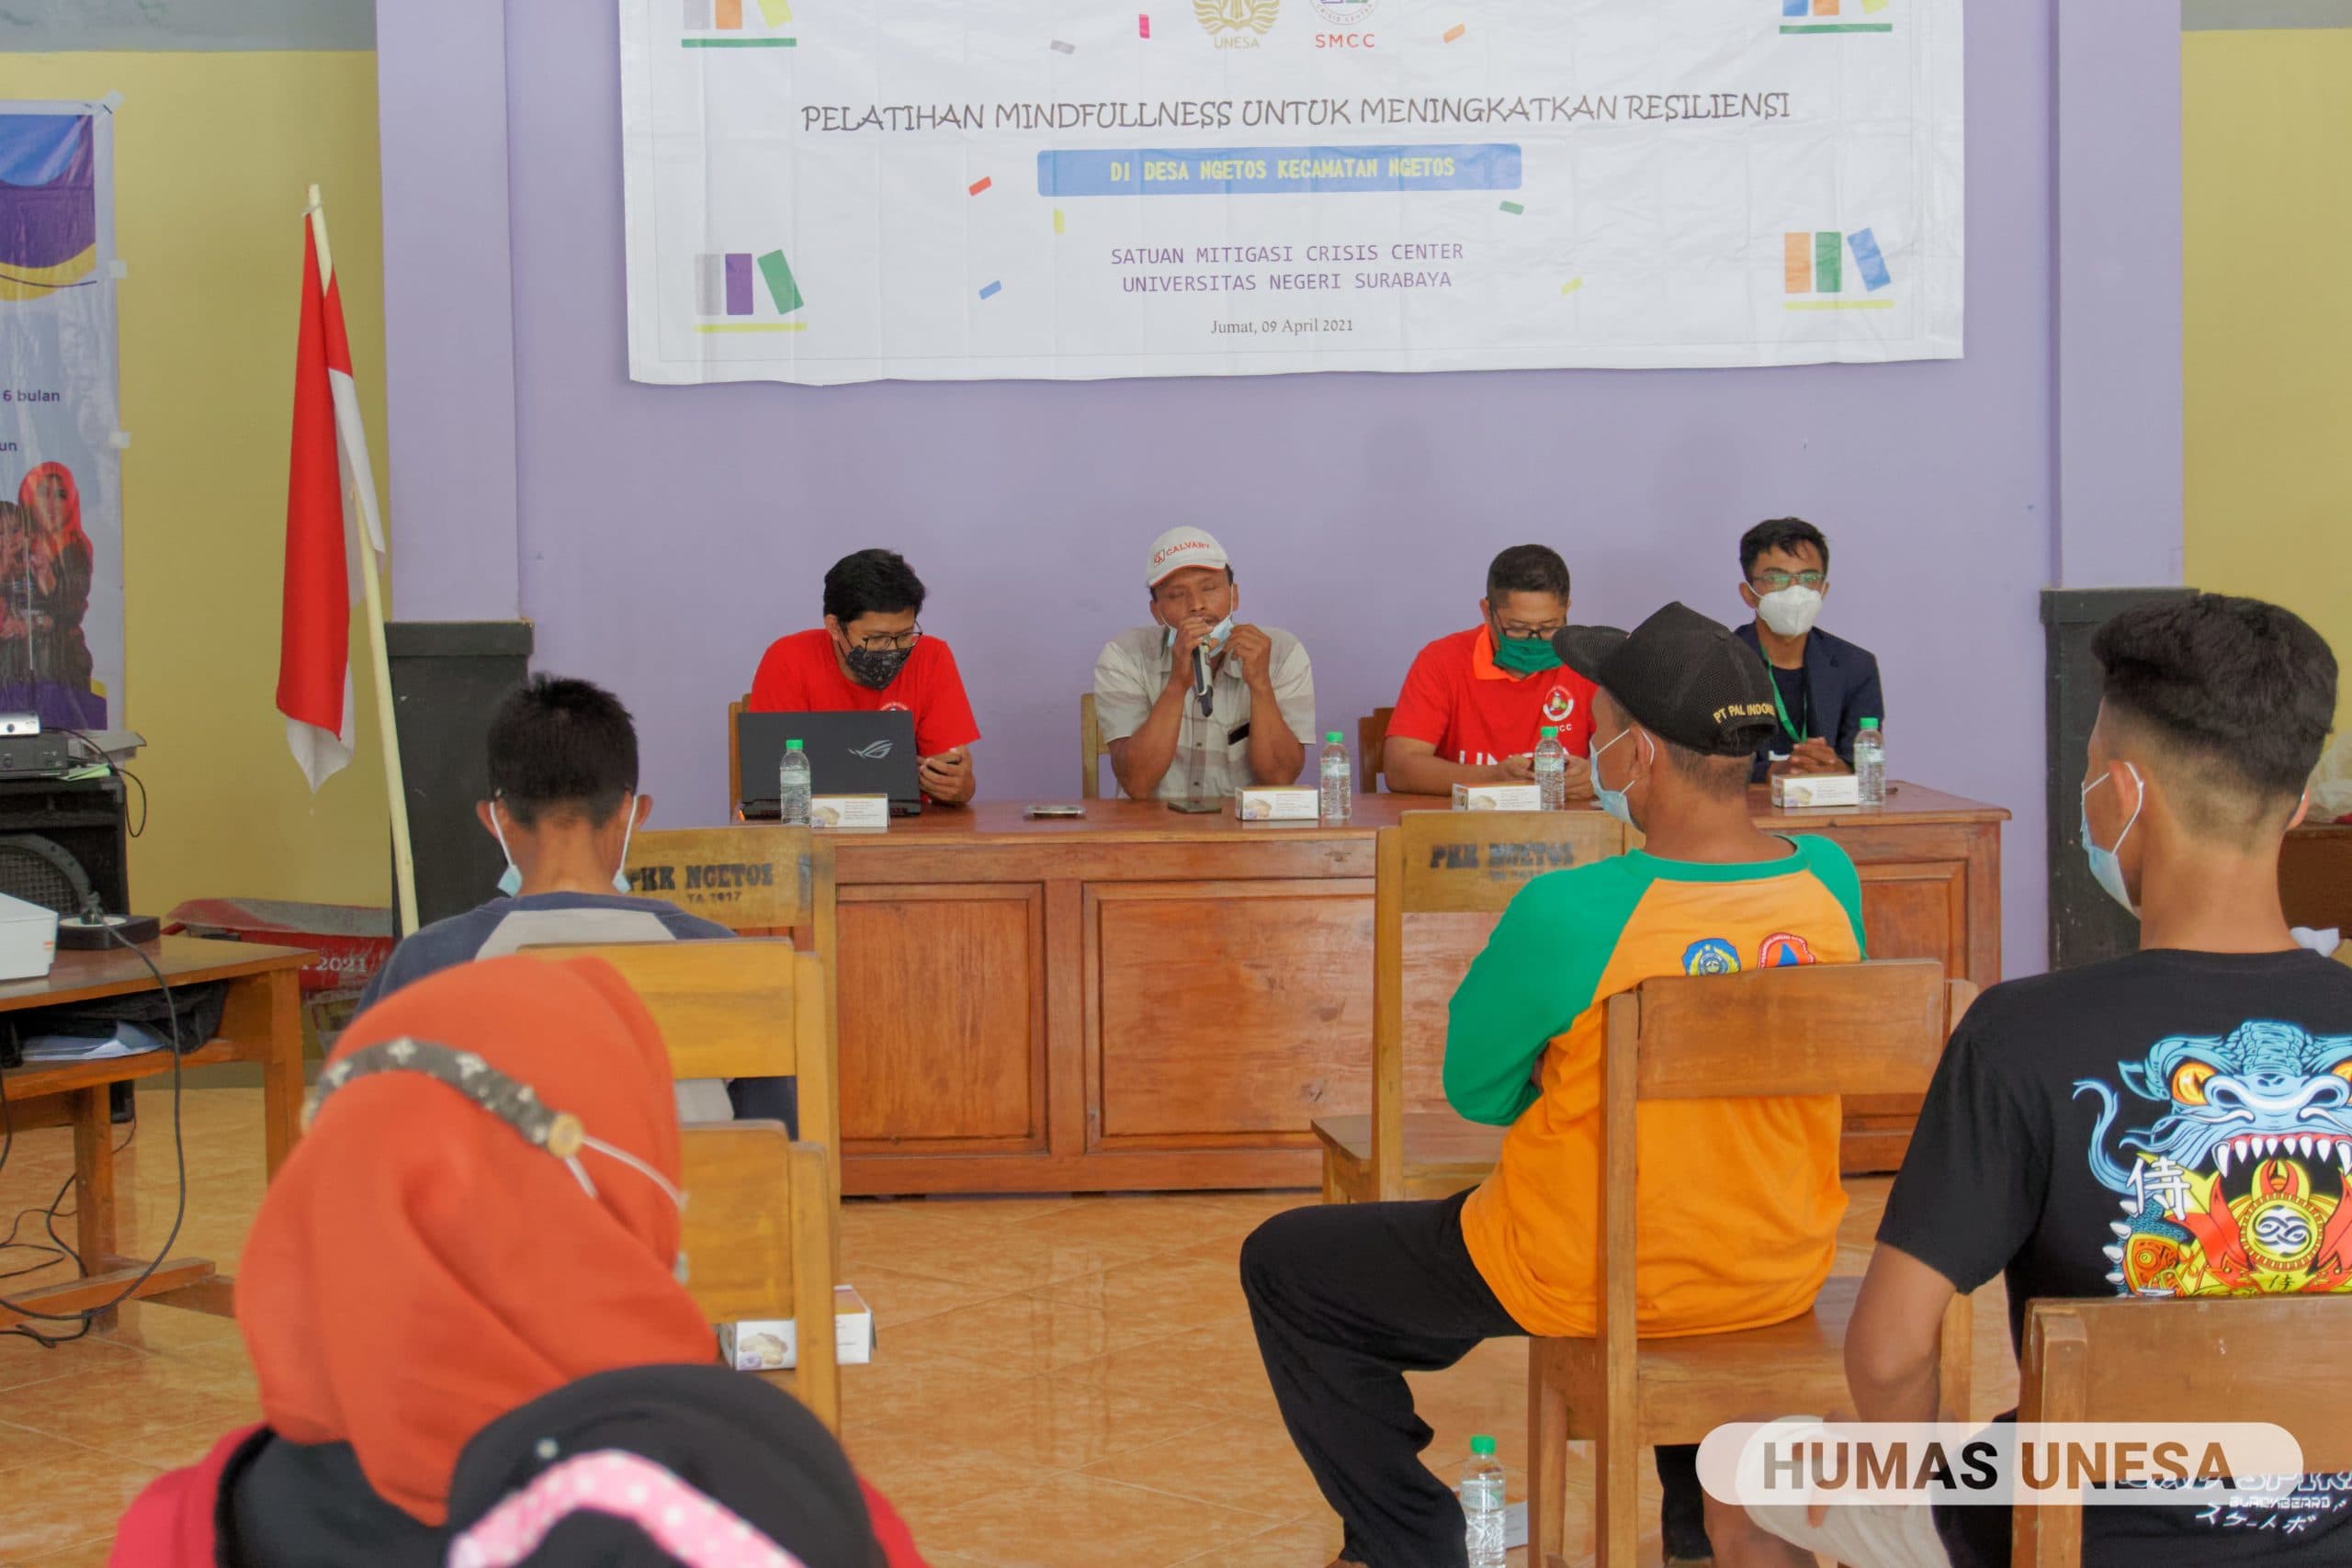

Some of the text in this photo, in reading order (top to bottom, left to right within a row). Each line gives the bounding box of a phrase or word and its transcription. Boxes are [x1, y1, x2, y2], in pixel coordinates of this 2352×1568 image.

[1214, 37, 1260, 49] UNESA
[1315, 33, 1375, 48] SMCC
[801, 92, 1791, 131] PELATIHAN MINDFULLNESS UNTUK MENINGKATKAN RESILIENSI
[1110, 156, 1455, 182] DI DESA NGETOS KECAMATAN NGETOS
[1112, 243, 1464, 265] SATUAN MITIGASI CRISIS CENTER
[1123, 271, 1452, 292] UNIVERSITAS NEGERI SURABAYA
[1211, 317, 1353, 336] Jumat, 09 April 2021
[3, 389, 61, 402] 6 bulan
[1713, 707, 1727, 724] PT
[1728, 704, 1746, 716] PAL
[2127, 1156, 2191, 1221] 侍
